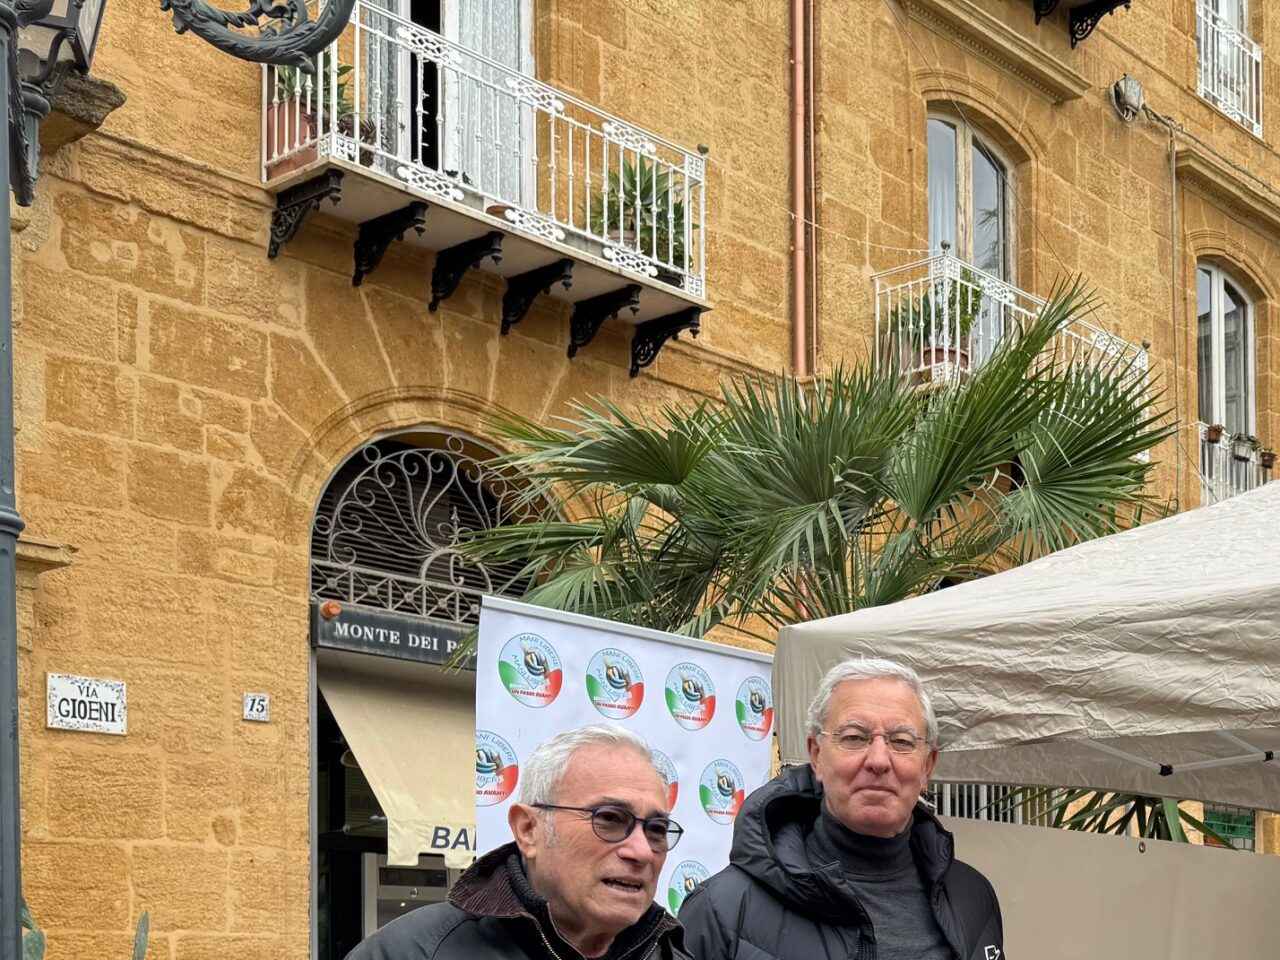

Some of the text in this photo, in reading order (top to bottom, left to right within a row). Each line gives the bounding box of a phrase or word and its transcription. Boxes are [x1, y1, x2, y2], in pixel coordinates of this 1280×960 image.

[333, 622, 400, 645] MONTE
[407, 633, 438, 650] DEI
[77, 685, 99, 698] VIA
[58, 697, 117, 722] GIOENI
[248, 698, 266, 713] 15
[430, 825, 477, 851] BA
